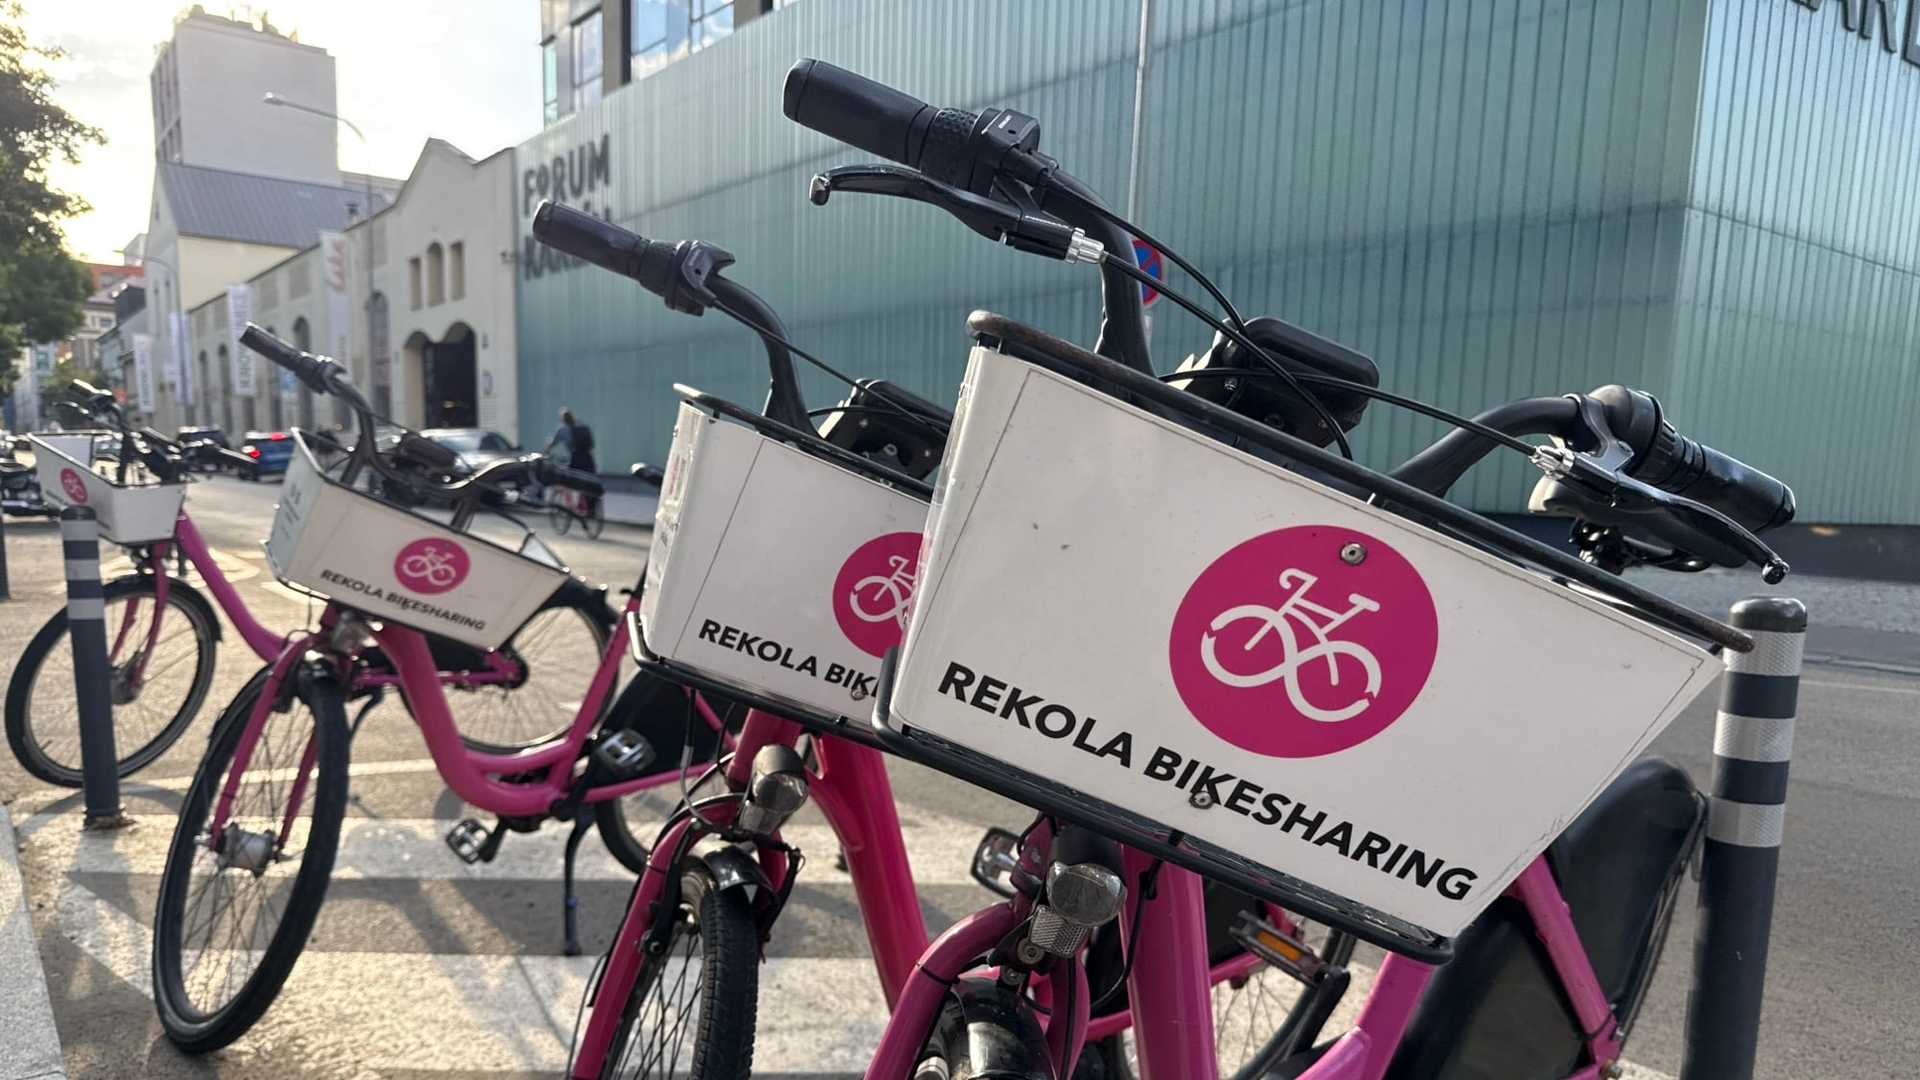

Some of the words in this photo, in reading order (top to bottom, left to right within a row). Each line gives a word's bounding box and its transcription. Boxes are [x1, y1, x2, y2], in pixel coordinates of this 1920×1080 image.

[523, 133, 610, 218] FORUM
[320, 569, 383, 599] REKOLA
[386, 592, 486, 631] BIKESHARING
[698, 618, 817, 677] REKOLA
[824, 662, 879, 699] BIK
[937, 661, 1133, 769] REKOLA
[1144, 746, 1478, 901] BIKESHARING
